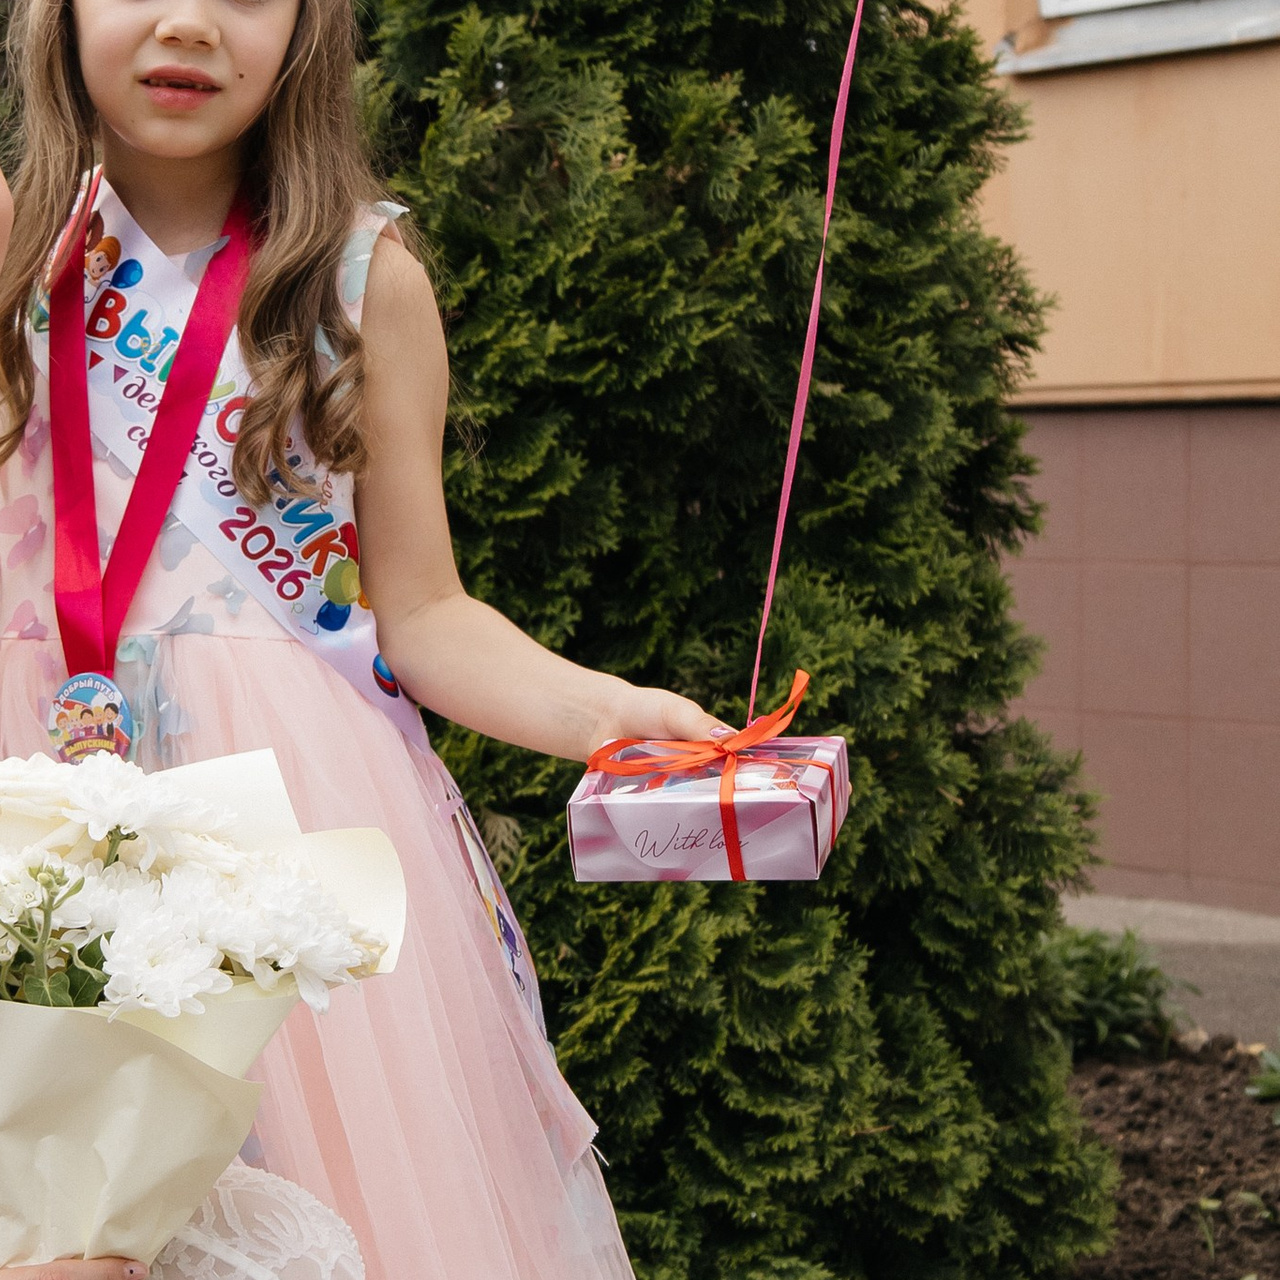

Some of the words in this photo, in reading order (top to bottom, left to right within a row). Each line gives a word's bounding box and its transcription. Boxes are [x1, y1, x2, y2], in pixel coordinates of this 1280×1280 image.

[123, 376, 237, 497] декого
[219, 506, 311, 601] 2026
[59, 677, 93, 705] ДОБРЫЙ
[94, 681, 115, 700] ПУТЬ
[64, 738, 117, 757] ВЫПУСКНИК
[635, 823, 708, 858] With
[709, 828, 749, 849] lo
